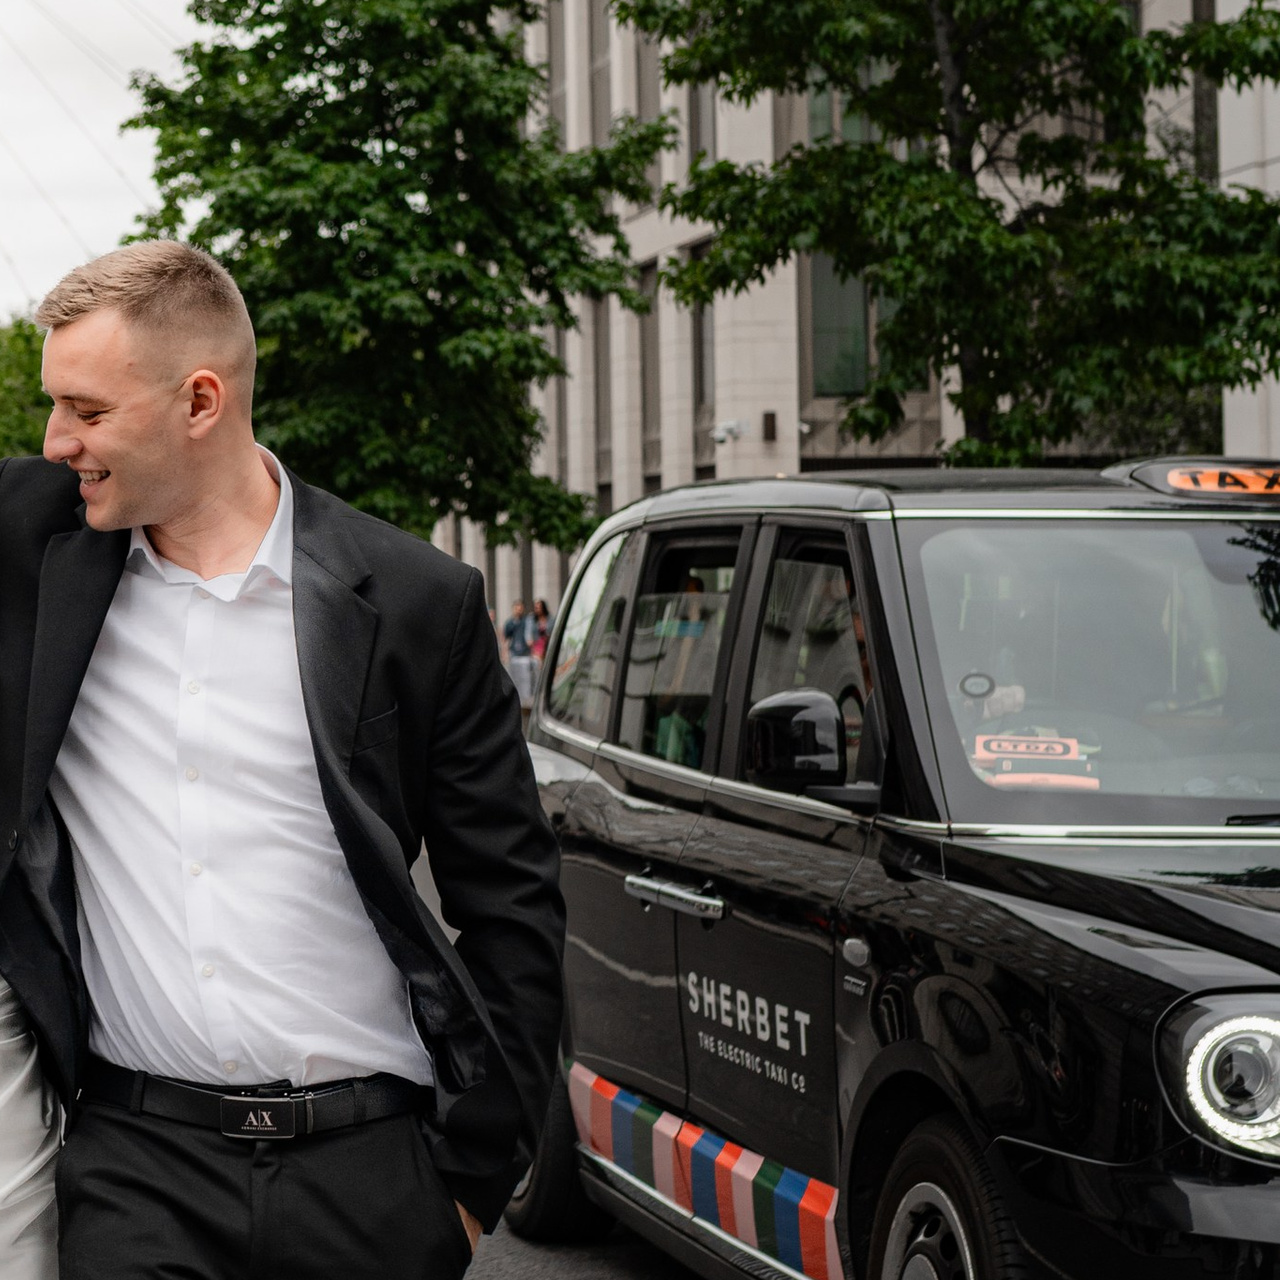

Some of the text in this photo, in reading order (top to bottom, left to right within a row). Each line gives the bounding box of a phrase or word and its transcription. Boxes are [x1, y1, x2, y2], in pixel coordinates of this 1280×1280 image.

[1179, 470, 1280, 490] TAX
[996, 741, 1057, 753] LTDA
[687, 971, 811, 1057] SHERBET
[698, 1031, 716, 1054] THE
[717, 1039, 762, 1074] ELECTRIC
[764, 1060, 788, 1086] TAXI
